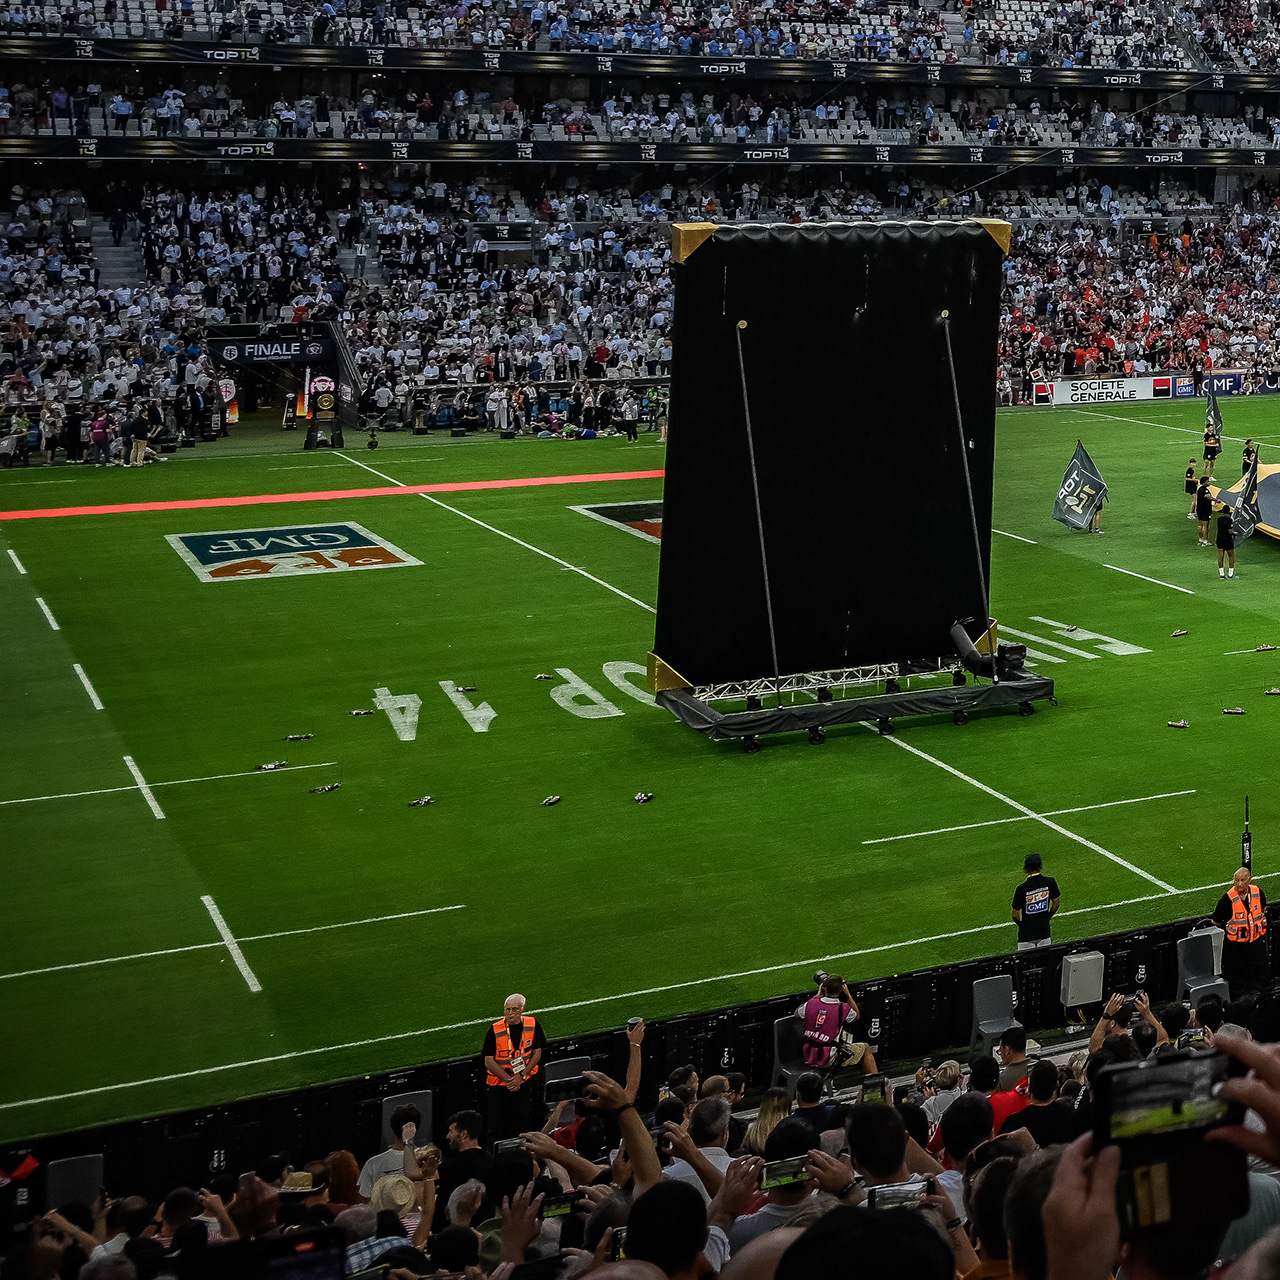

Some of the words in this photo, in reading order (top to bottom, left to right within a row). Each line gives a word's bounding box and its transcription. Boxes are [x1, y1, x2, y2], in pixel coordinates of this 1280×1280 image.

[245, 343, 300, 356] FINALE
[1071, 380, 1125, 391] SOCIETE
[1177, 386, 1194, 395] GMF
[1071, 390, 1136, 402] GENERALE
[1058, 470, 1080, 500] TOP
[209, 533, 350, 554] GMF
[372, 680, 498, 741] 14
[1028, 902, 1047, 911] GMF
